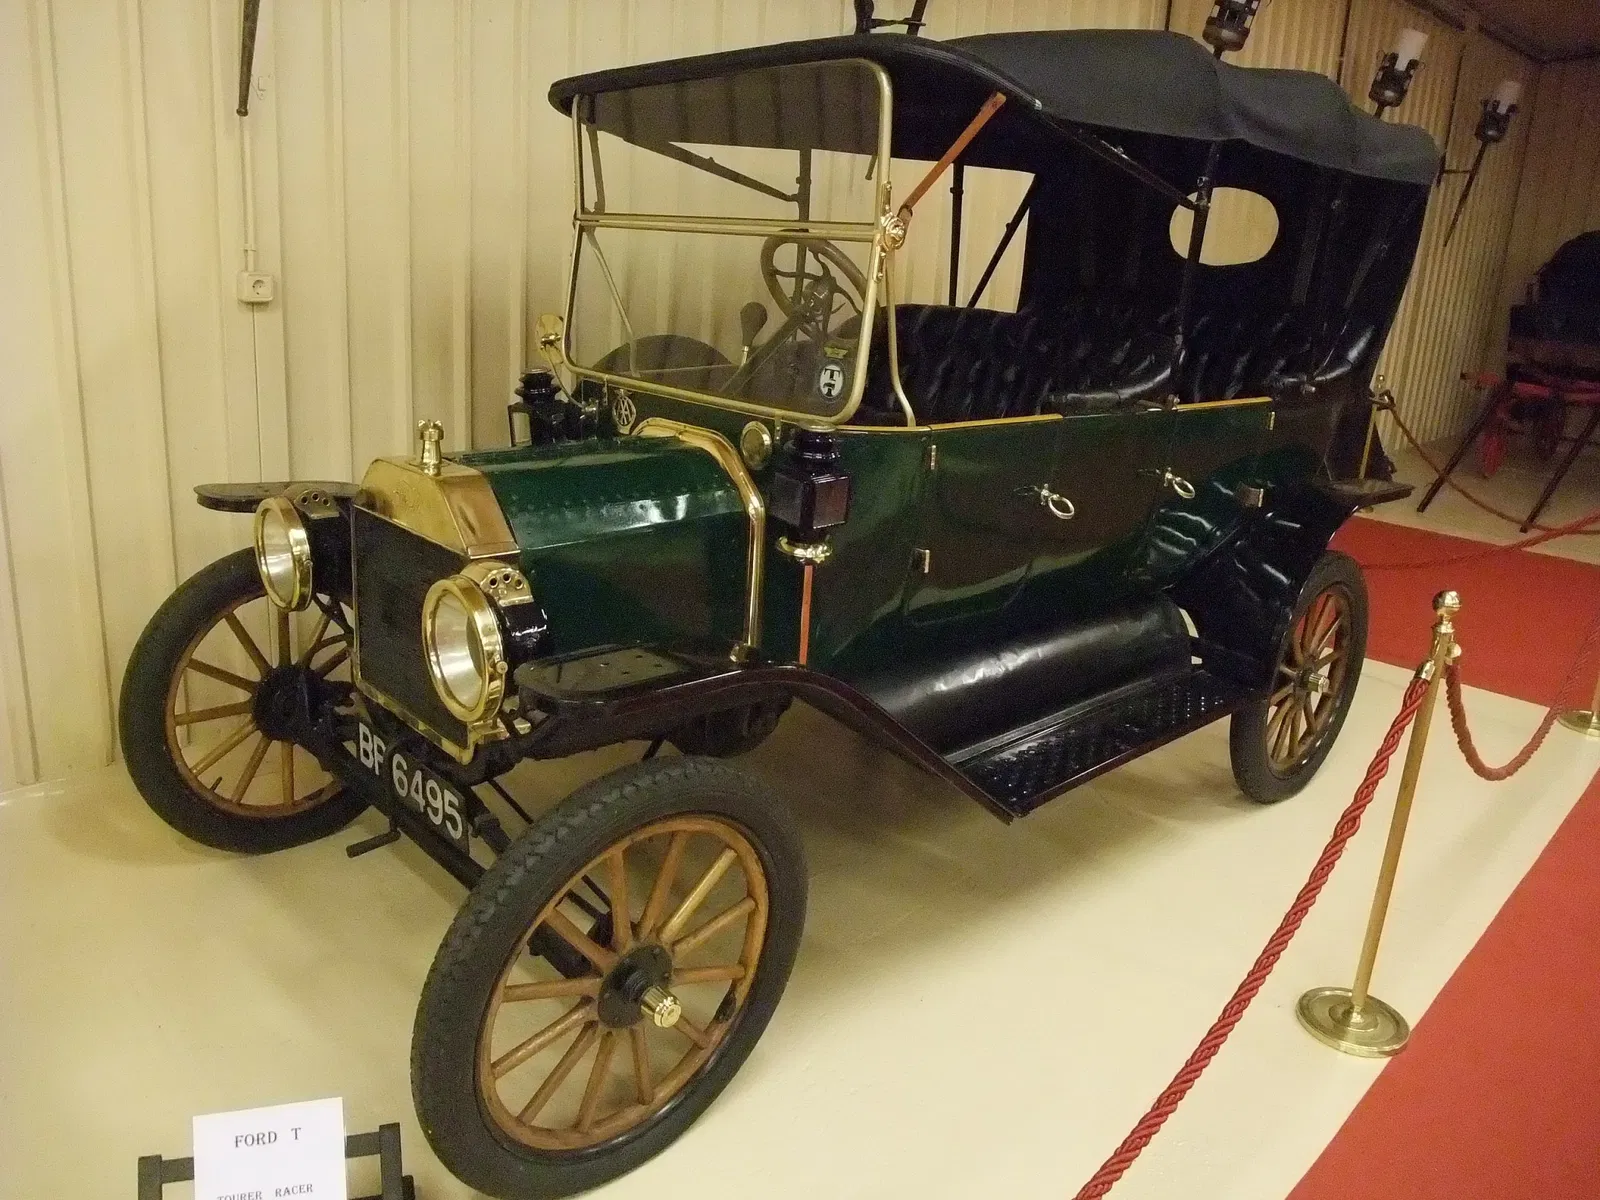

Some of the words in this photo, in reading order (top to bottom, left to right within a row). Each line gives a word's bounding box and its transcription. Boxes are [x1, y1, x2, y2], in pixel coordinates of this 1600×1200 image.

[392, 753, 462, 839] 6495
[234, 1131, 277, 1148] FORD
[291, 1127, 302, 1141] T
[275, 1183, 313, 1198] RACER
